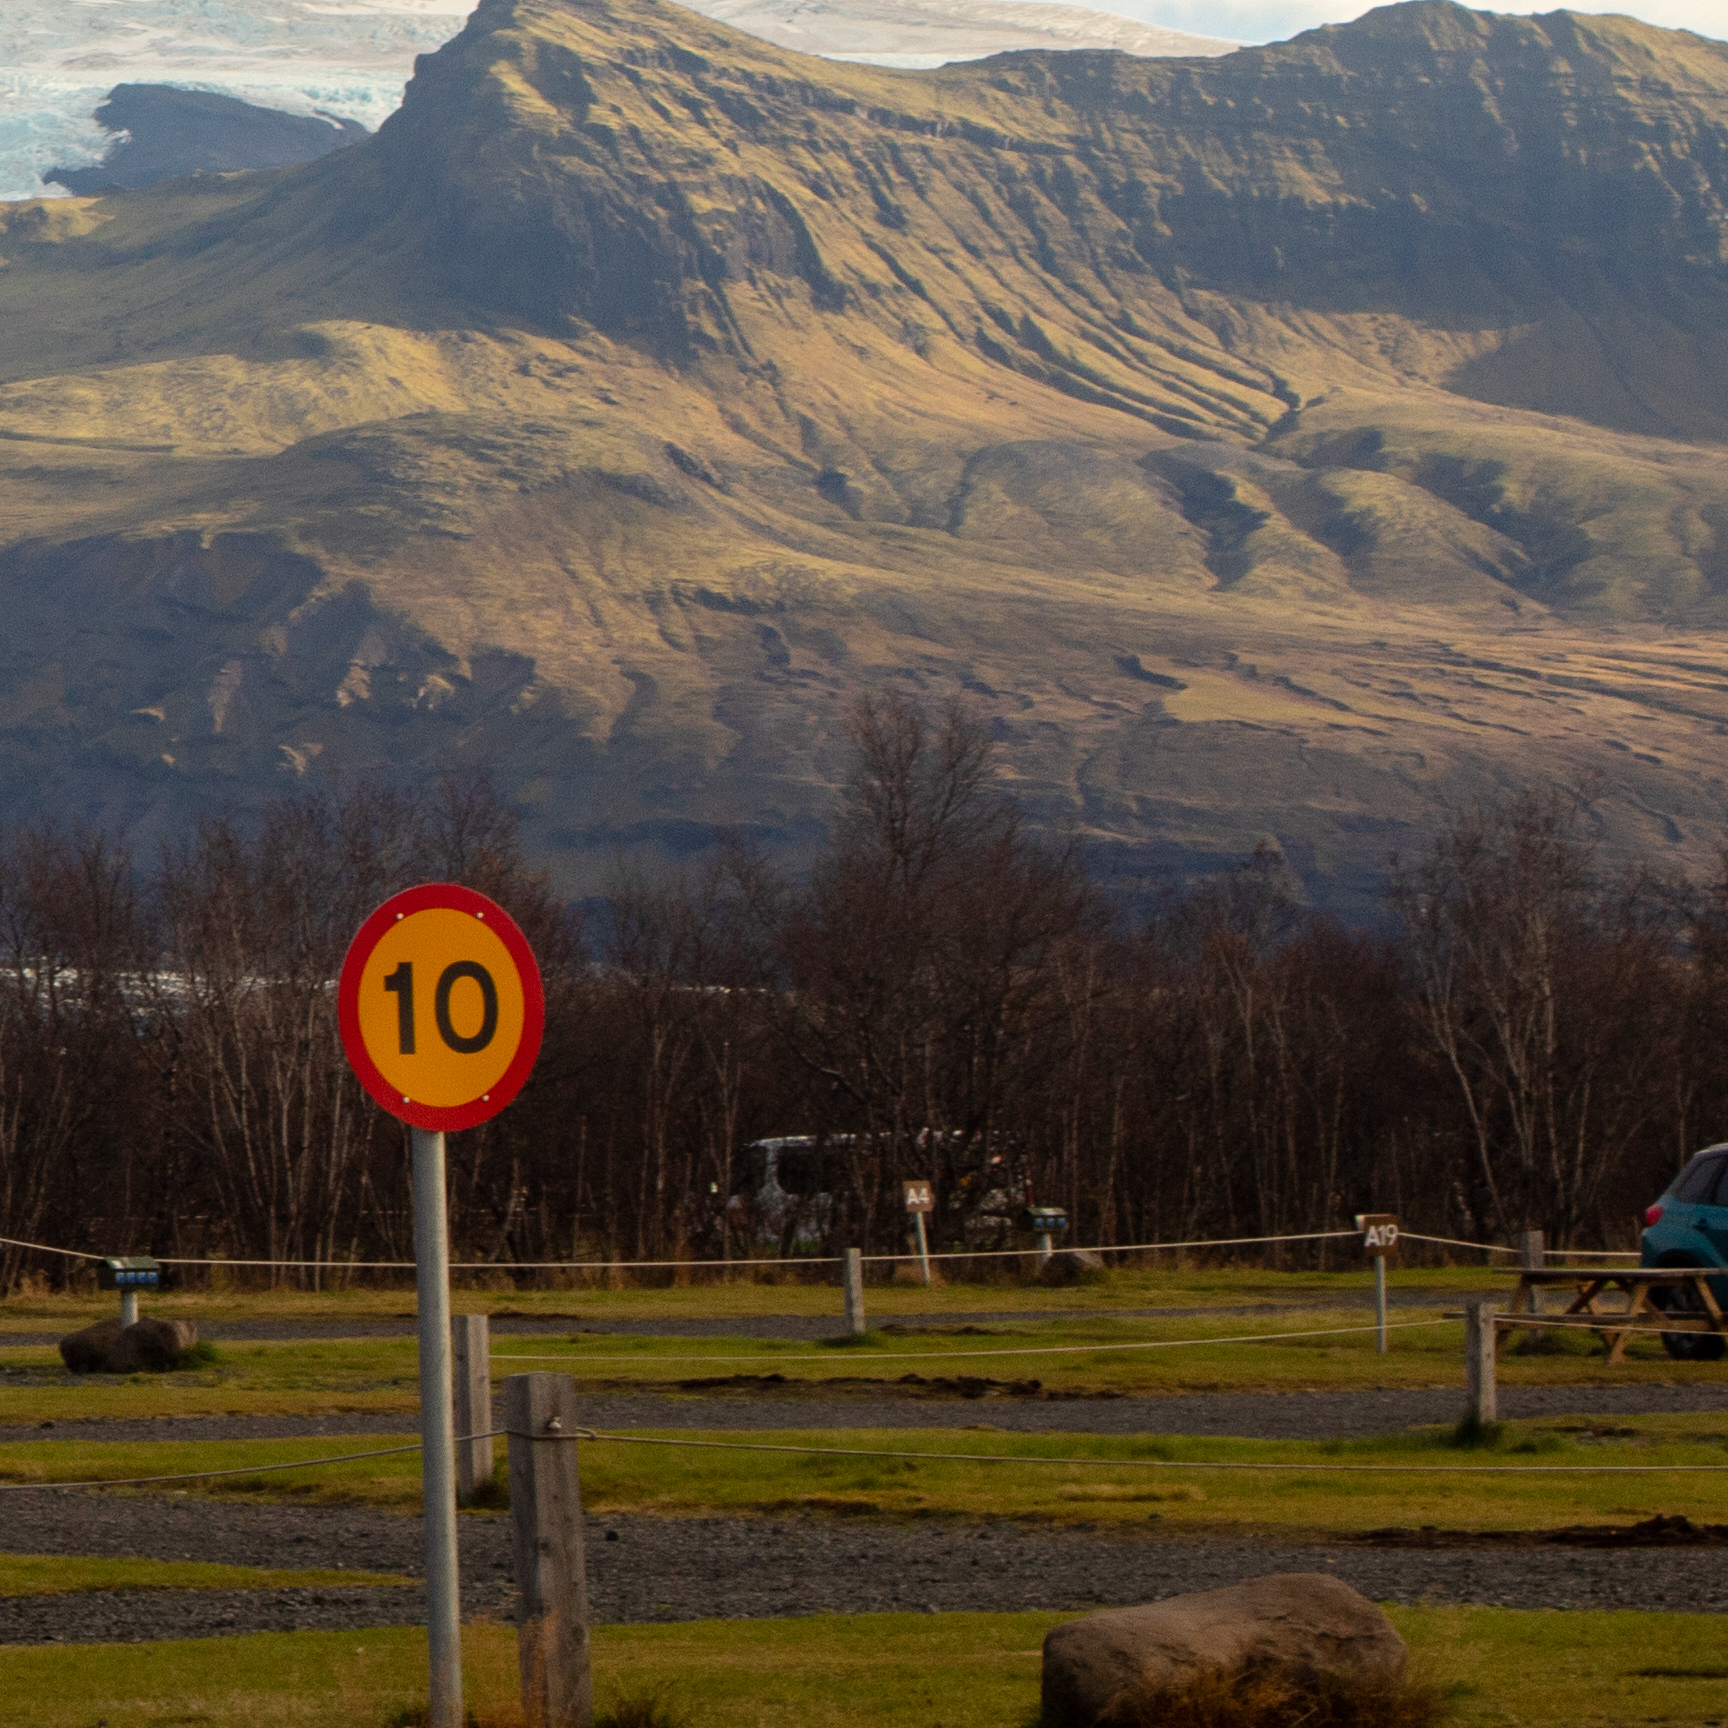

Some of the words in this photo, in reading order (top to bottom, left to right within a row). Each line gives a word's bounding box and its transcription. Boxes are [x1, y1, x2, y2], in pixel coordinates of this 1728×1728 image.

[384, 960, 498, 1055] 10
[906, 1187, 930, 1204] A4
[1365, 1224, 1398, 1246] A19
